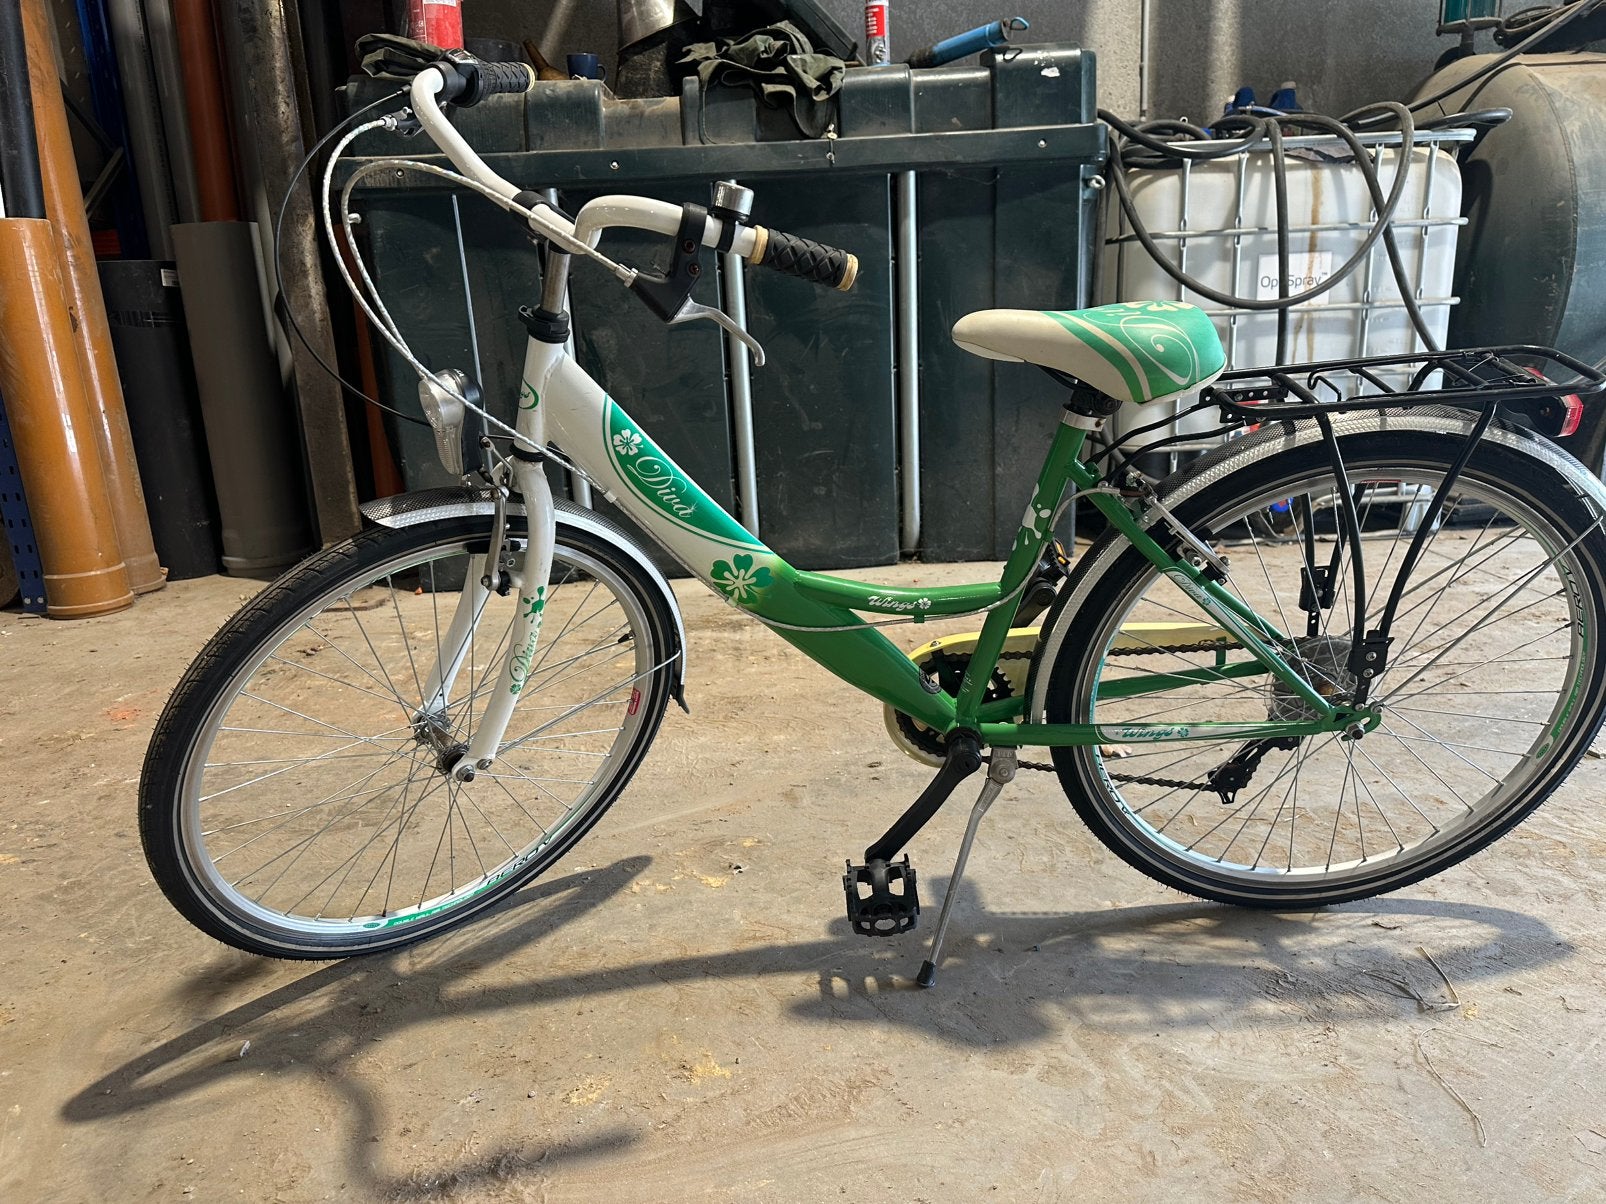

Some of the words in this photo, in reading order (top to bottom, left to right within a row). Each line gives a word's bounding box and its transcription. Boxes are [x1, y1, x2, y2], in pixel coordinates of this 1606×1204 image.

[627, 456, 694, 518] Diva
[868, 595, 918, 611] Wings
[1569, 580, 1584, 638] AERO
[1121, 727, 1175, 740] Wings
